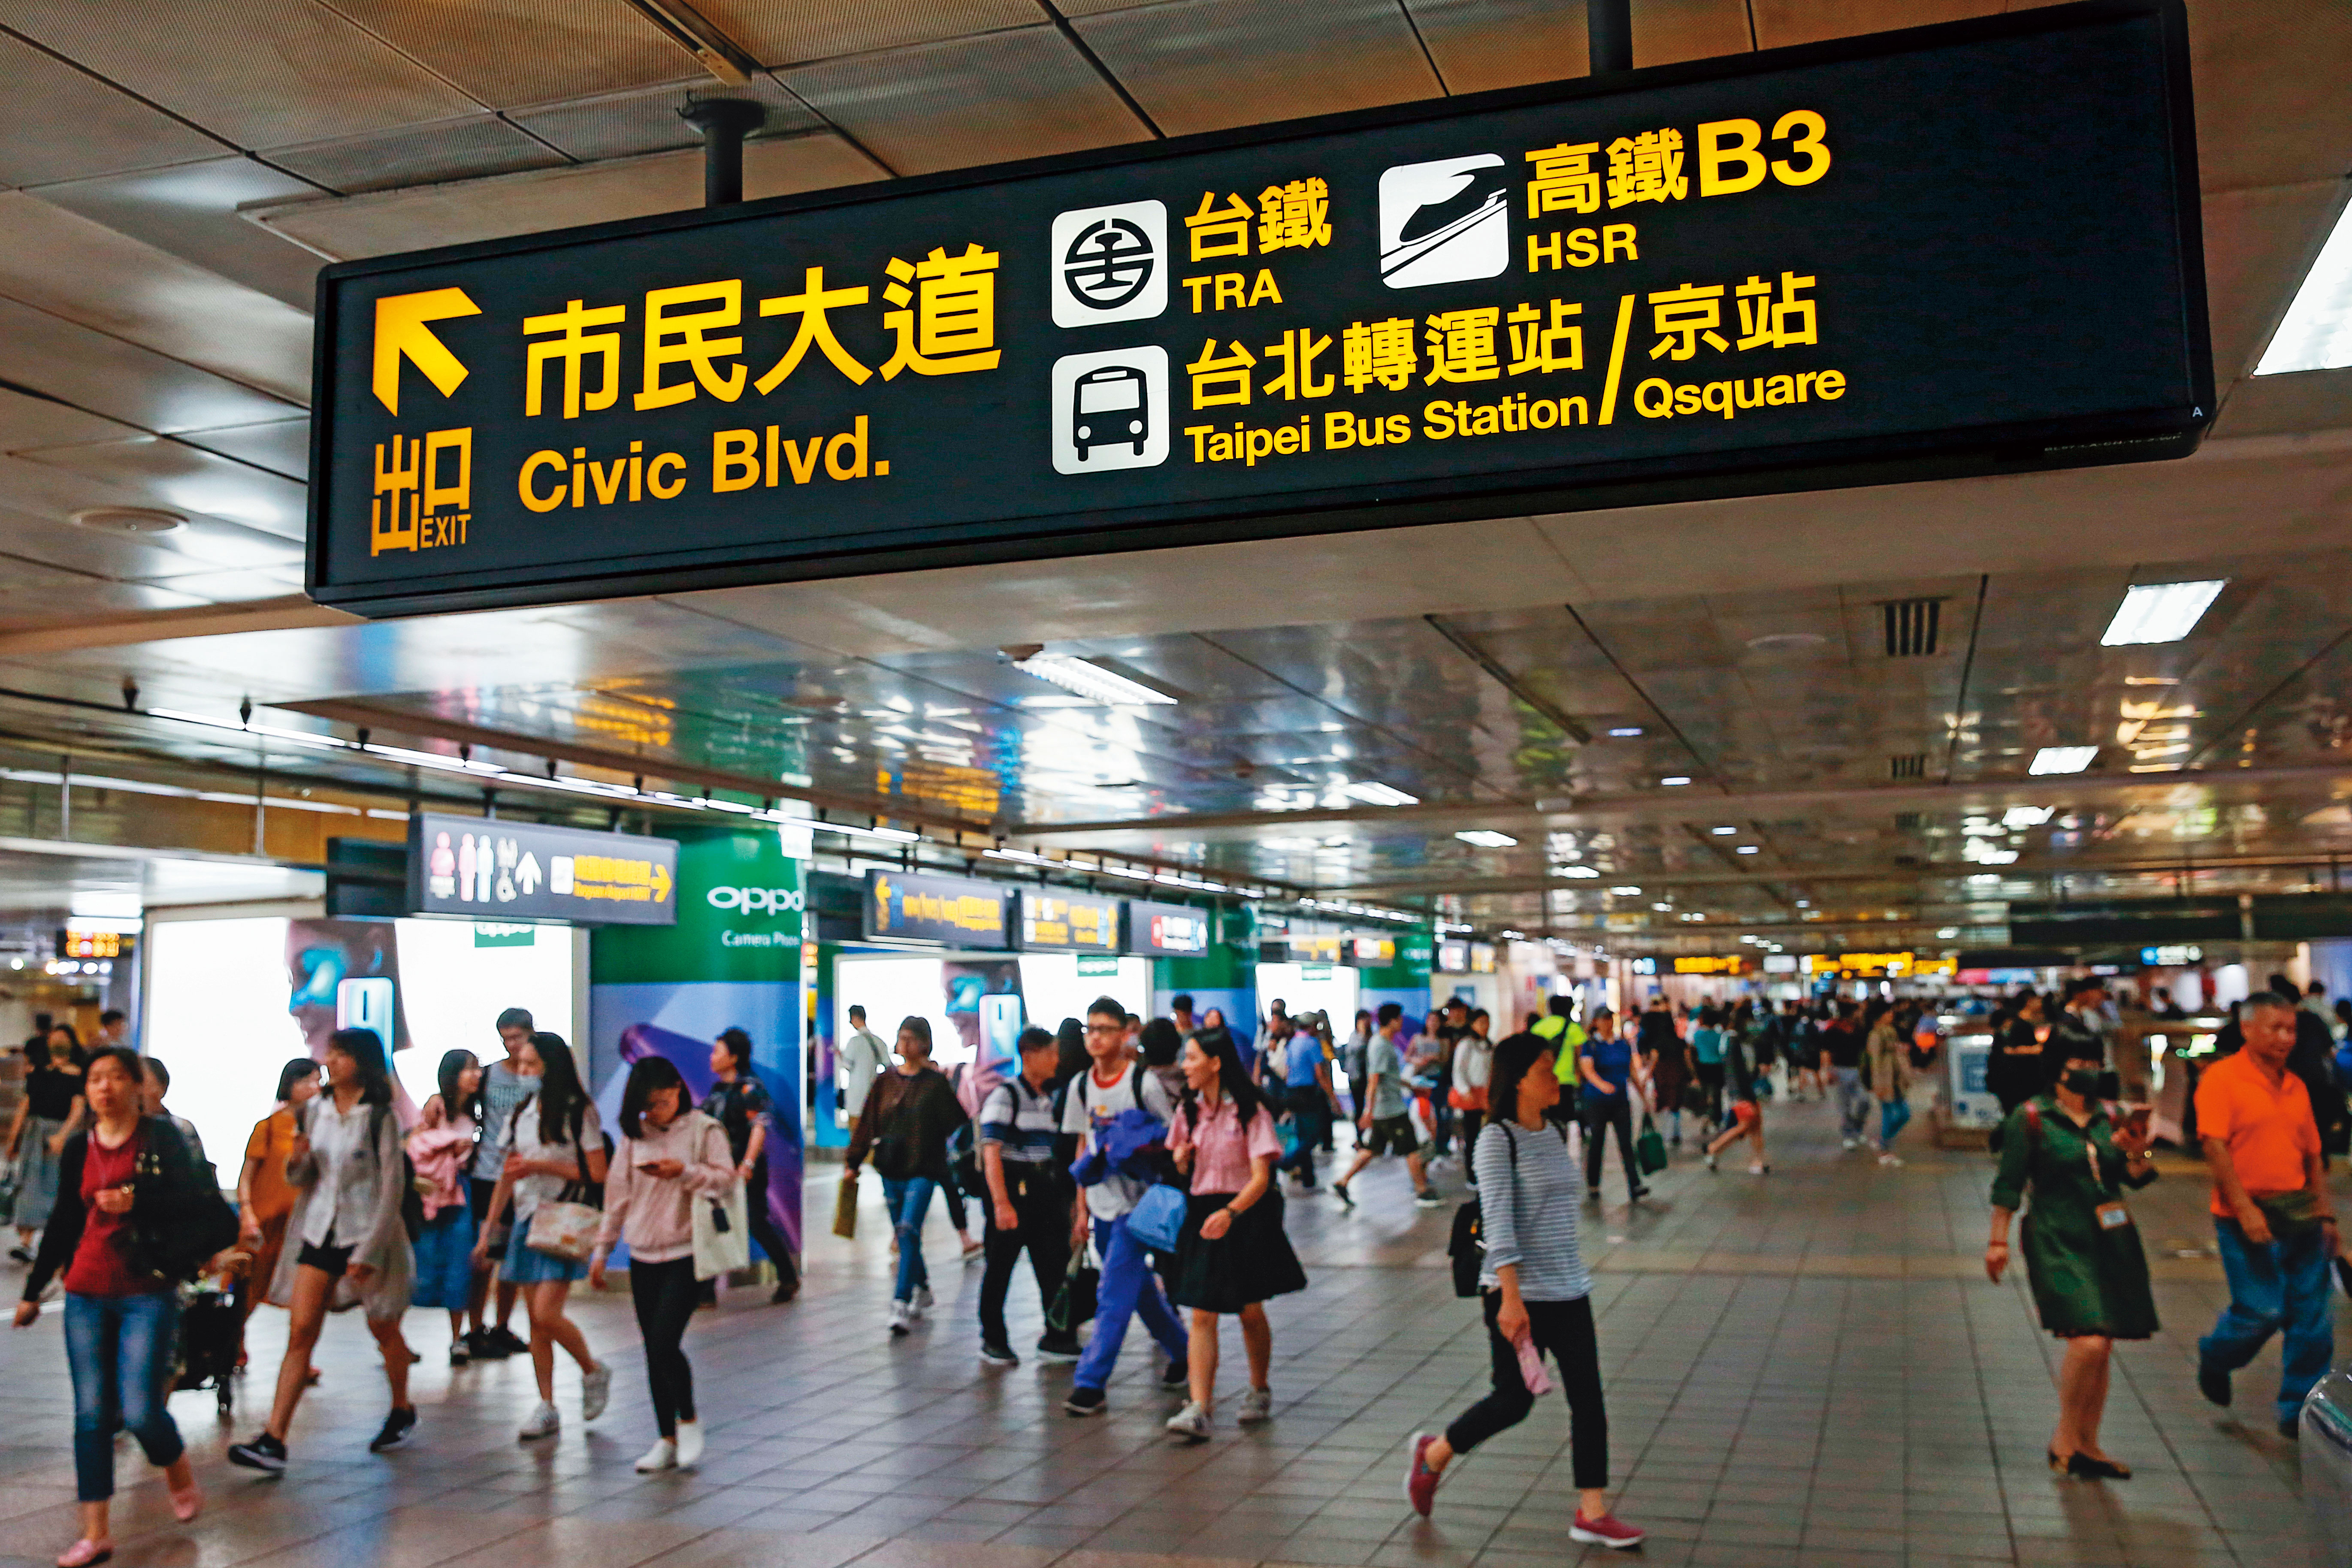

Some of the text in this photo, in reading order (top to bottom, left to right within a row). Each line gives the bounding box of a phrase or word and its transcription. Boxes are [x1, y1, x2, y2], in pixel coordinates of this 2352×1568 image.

[1184, 176, 1332, 263] 台鐵
[1527, 223, 1639, 273] HSR
[523, 242, 1002, 420] 市民大道
[1182, 268, 1283, 314] TRA
[1185, 298, 1584, 411] 台北轉運站
[1648, 271, 1818, 361] 京站
[518, 415, 889, 513] Civic Blvd.
[1184, 369, 1846, 467] Taipei Bus Station Qsquare
[371, 426, 472, 557] 出口
[420, 514, 472, 548] EXIT
